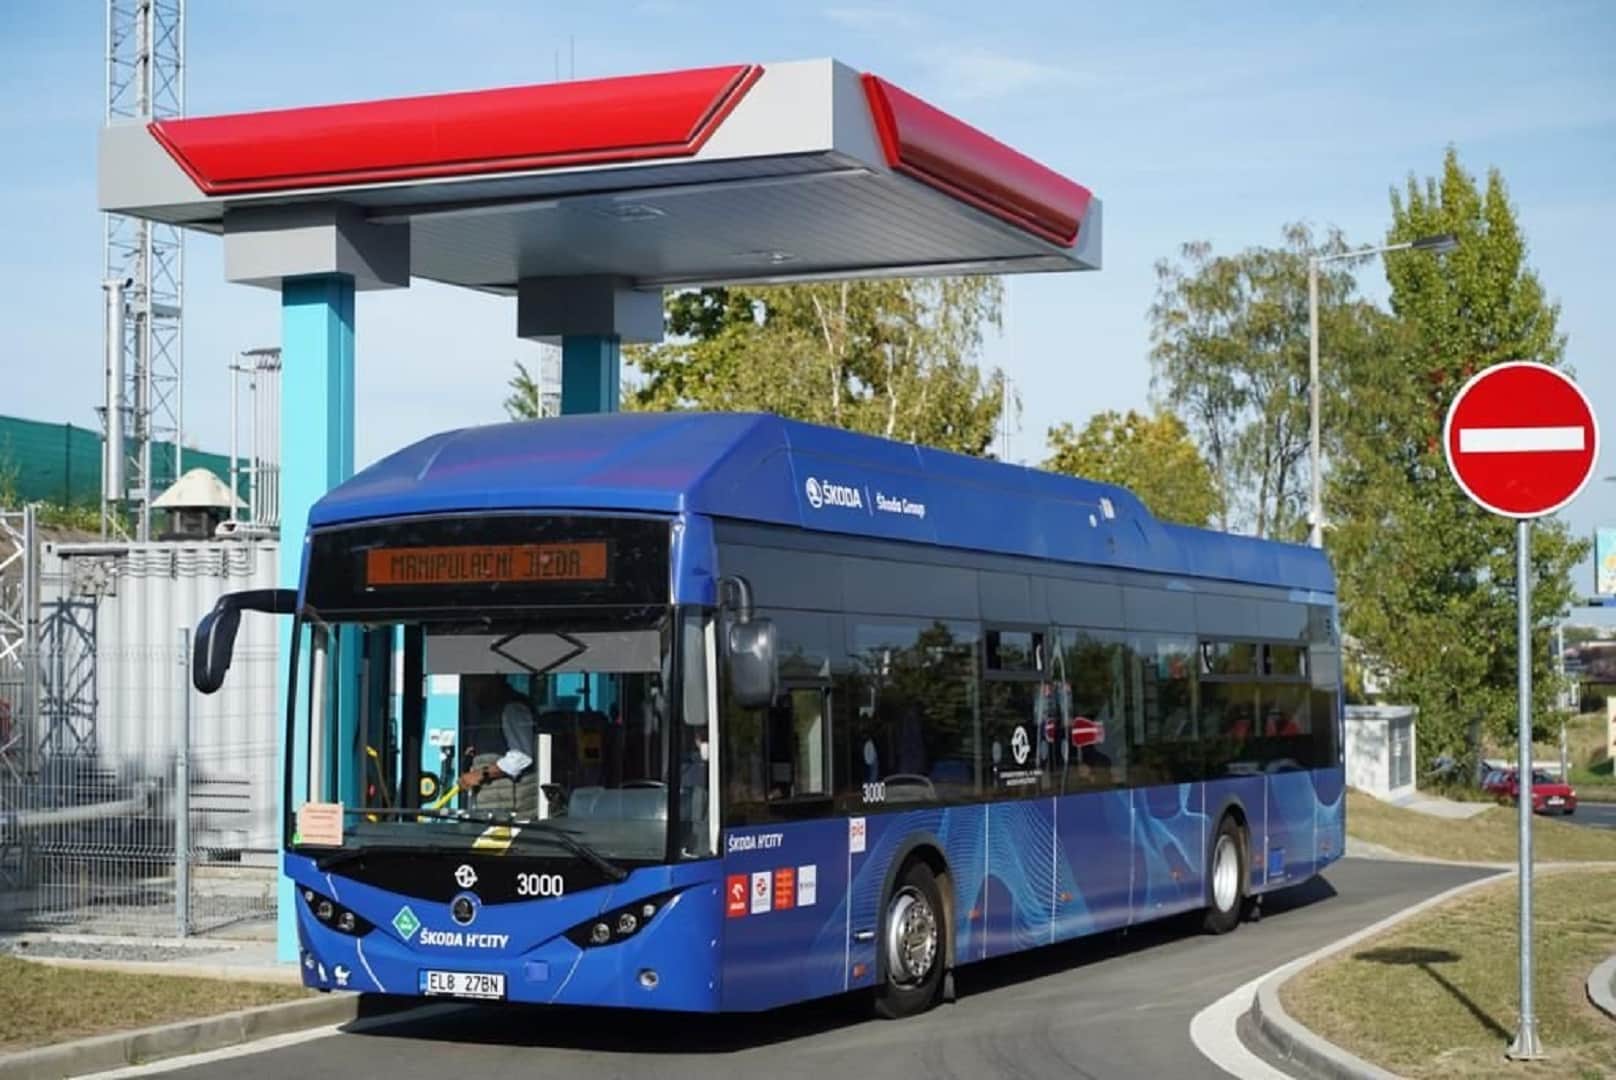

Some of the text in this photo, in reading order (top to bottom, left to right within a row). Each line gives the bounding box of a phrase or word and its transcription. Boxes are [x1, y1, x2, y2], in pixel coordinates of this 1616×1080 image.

[822, 479, 863, 509] ŠKODA
[862, 782, 886, 802] 3000
[728, 834, 756, 853] ŠKODA
[517, 872, 563, 896] 3000
[420, 927, 463, 947] ŠKODA
[429, 973, 498, 993] EL8 27BN
